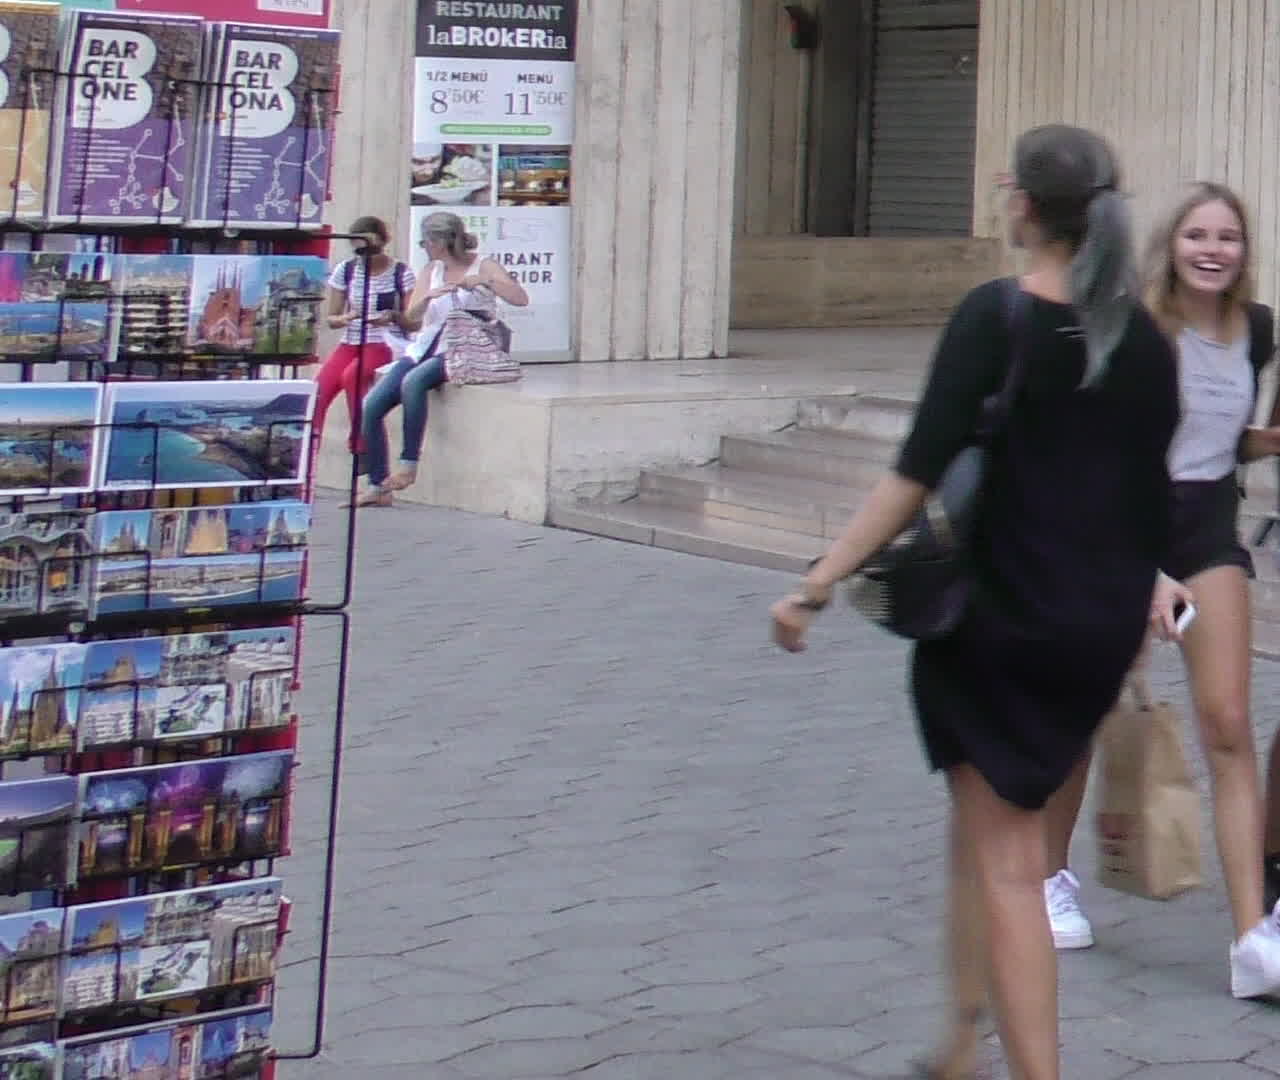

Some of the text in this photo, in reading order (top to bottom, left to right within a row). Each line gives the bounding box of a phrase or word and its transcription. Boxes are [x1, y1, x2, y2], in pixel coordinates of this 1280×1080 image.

[436, 0, 563, 22] RESTAURANT
[87, 38, 140, 59] BAR
[83, 59, 129, 80] CEL
[234, 49, 283, 71] BAR
[81, 80, 138, 102] ONE
[232, 70, 274, 90] CEL
[229, 89, 284, 112] ONA
